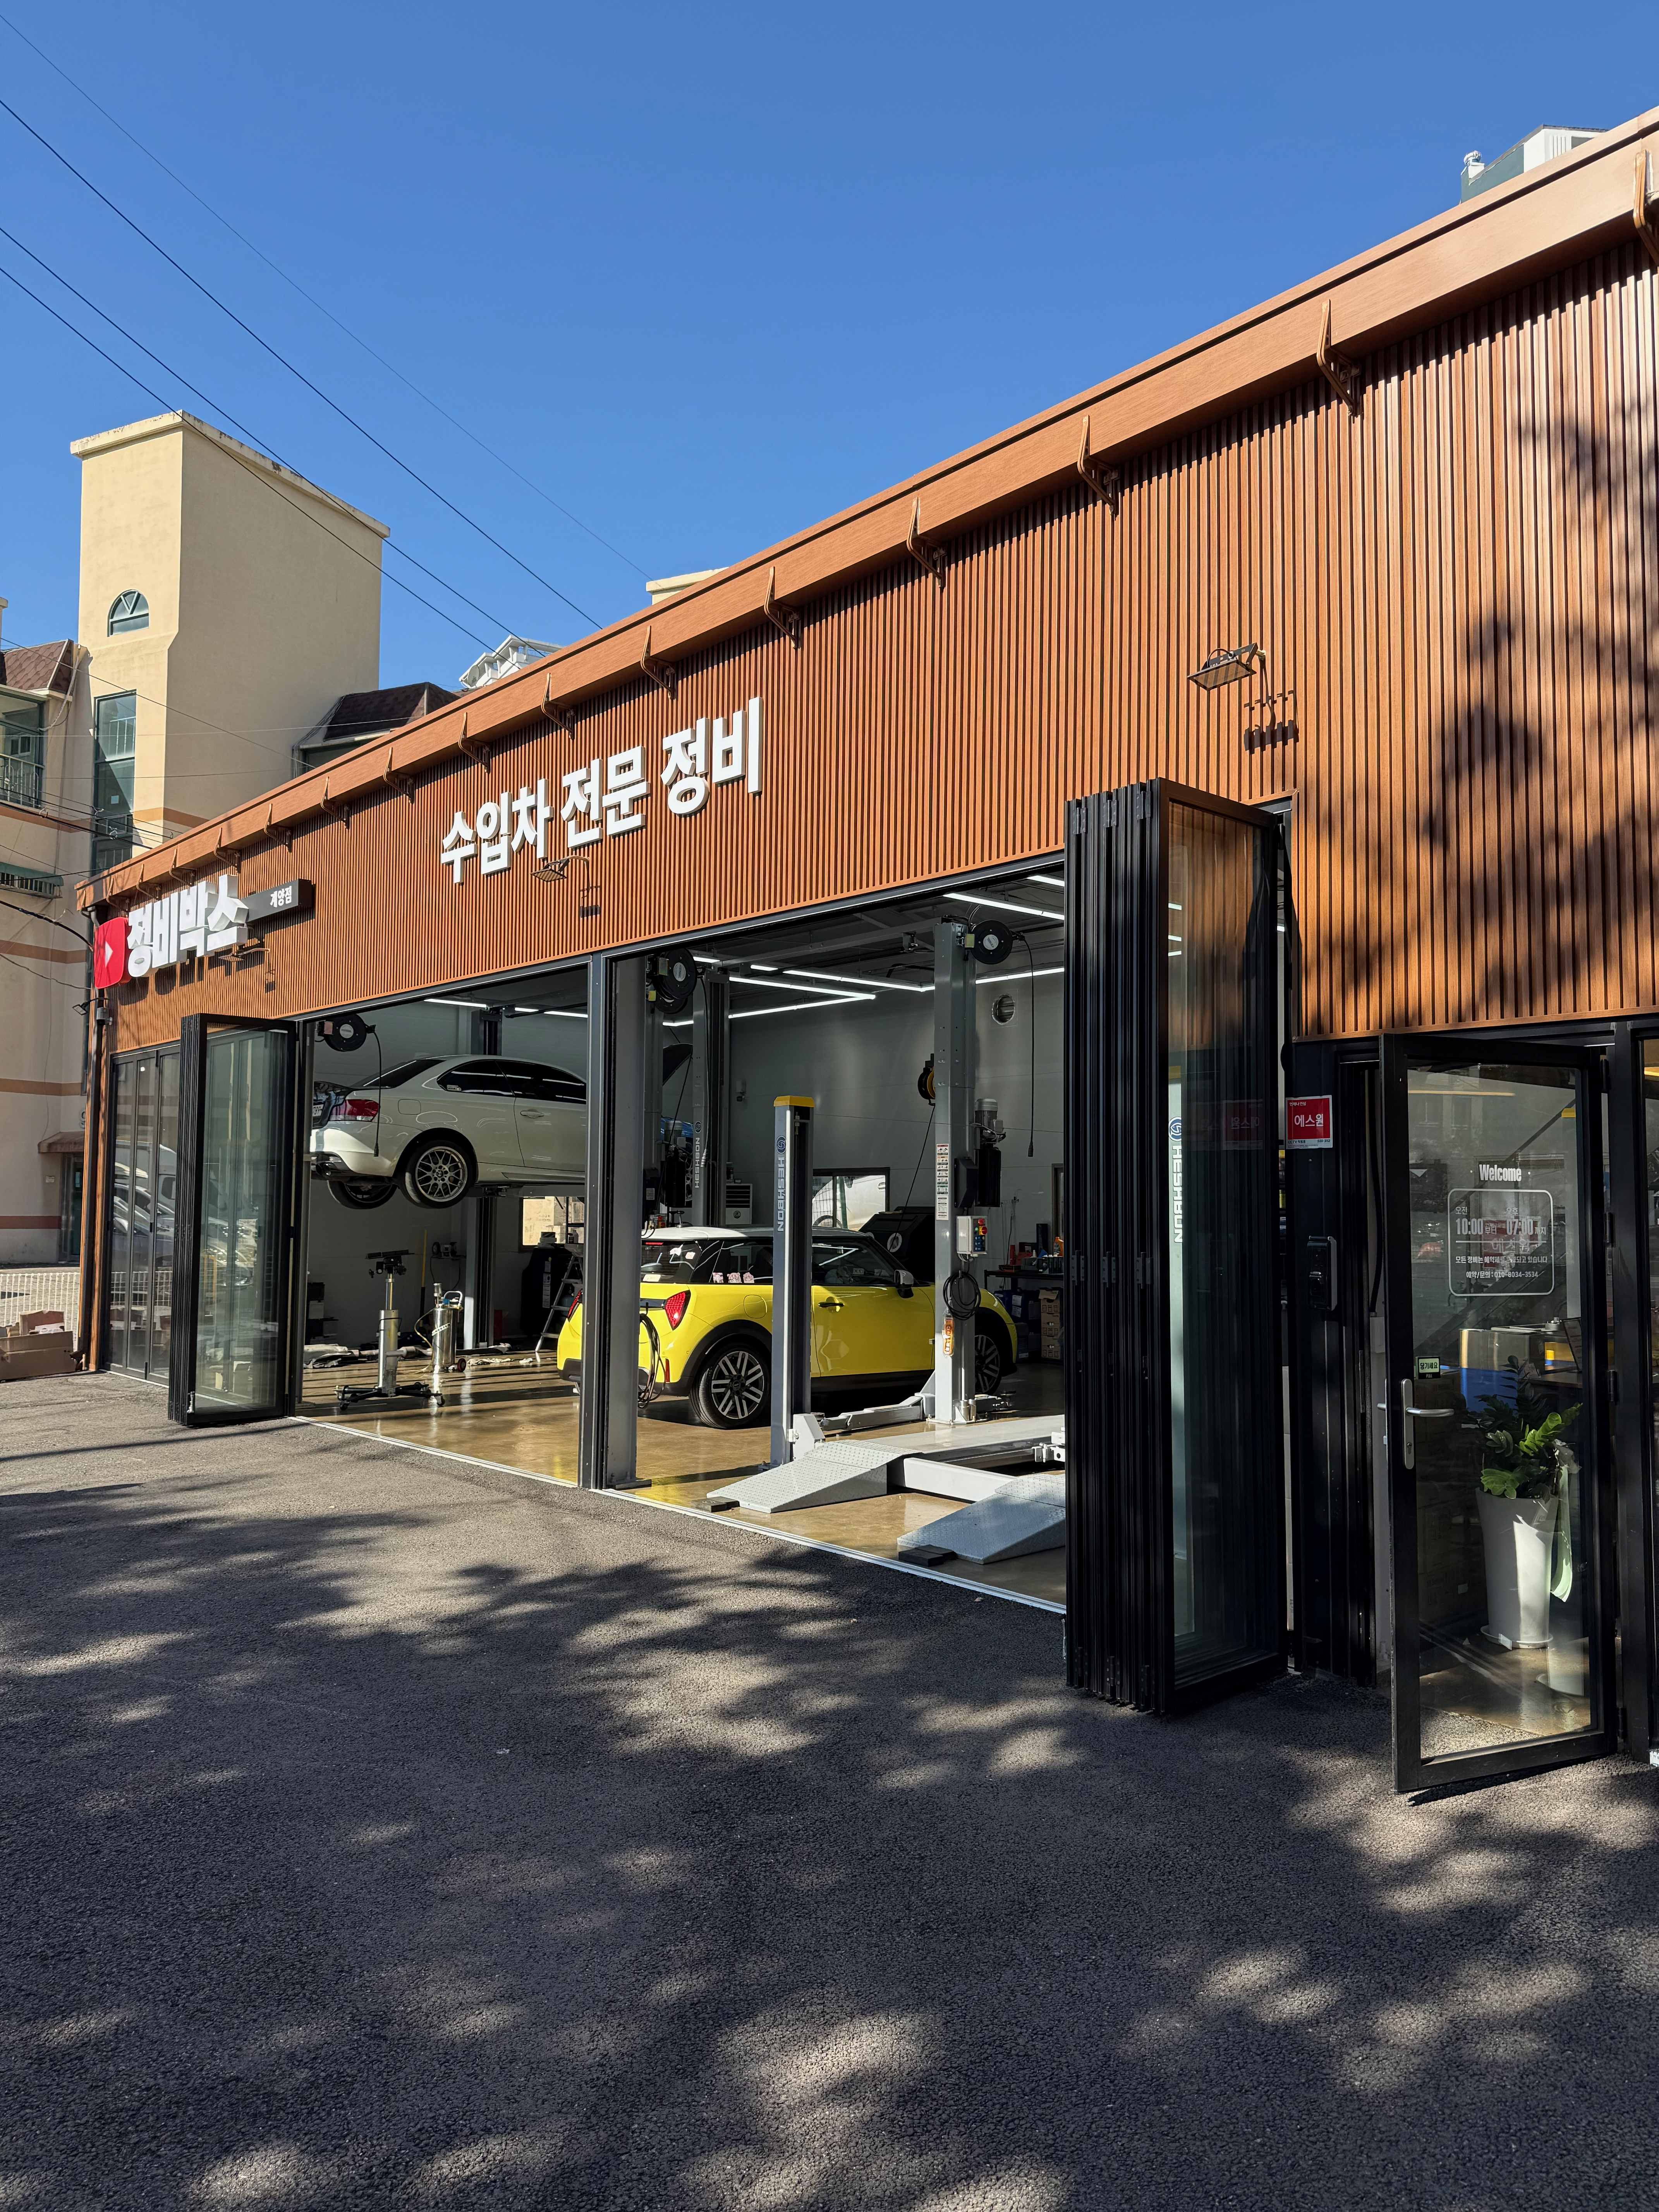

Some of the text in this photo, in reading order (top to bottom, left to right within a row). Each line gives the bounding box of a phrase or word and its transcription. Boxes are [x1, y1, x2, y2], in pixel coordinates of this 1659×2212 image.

[440, 696, 763, 884] 수입차 전문 정비
[270, 885, 292, 908] 계양점
[127, 874, 249, 978] 정비박스
[1294, 1113, 1324, 1127] 에스원
[1479, 1164, 1522, 1182] Welcome
[1506, 1207, 1518, 1216] 오후
[1456, 1218, 1546, 1235] 10:00 부터 07:00 까지
